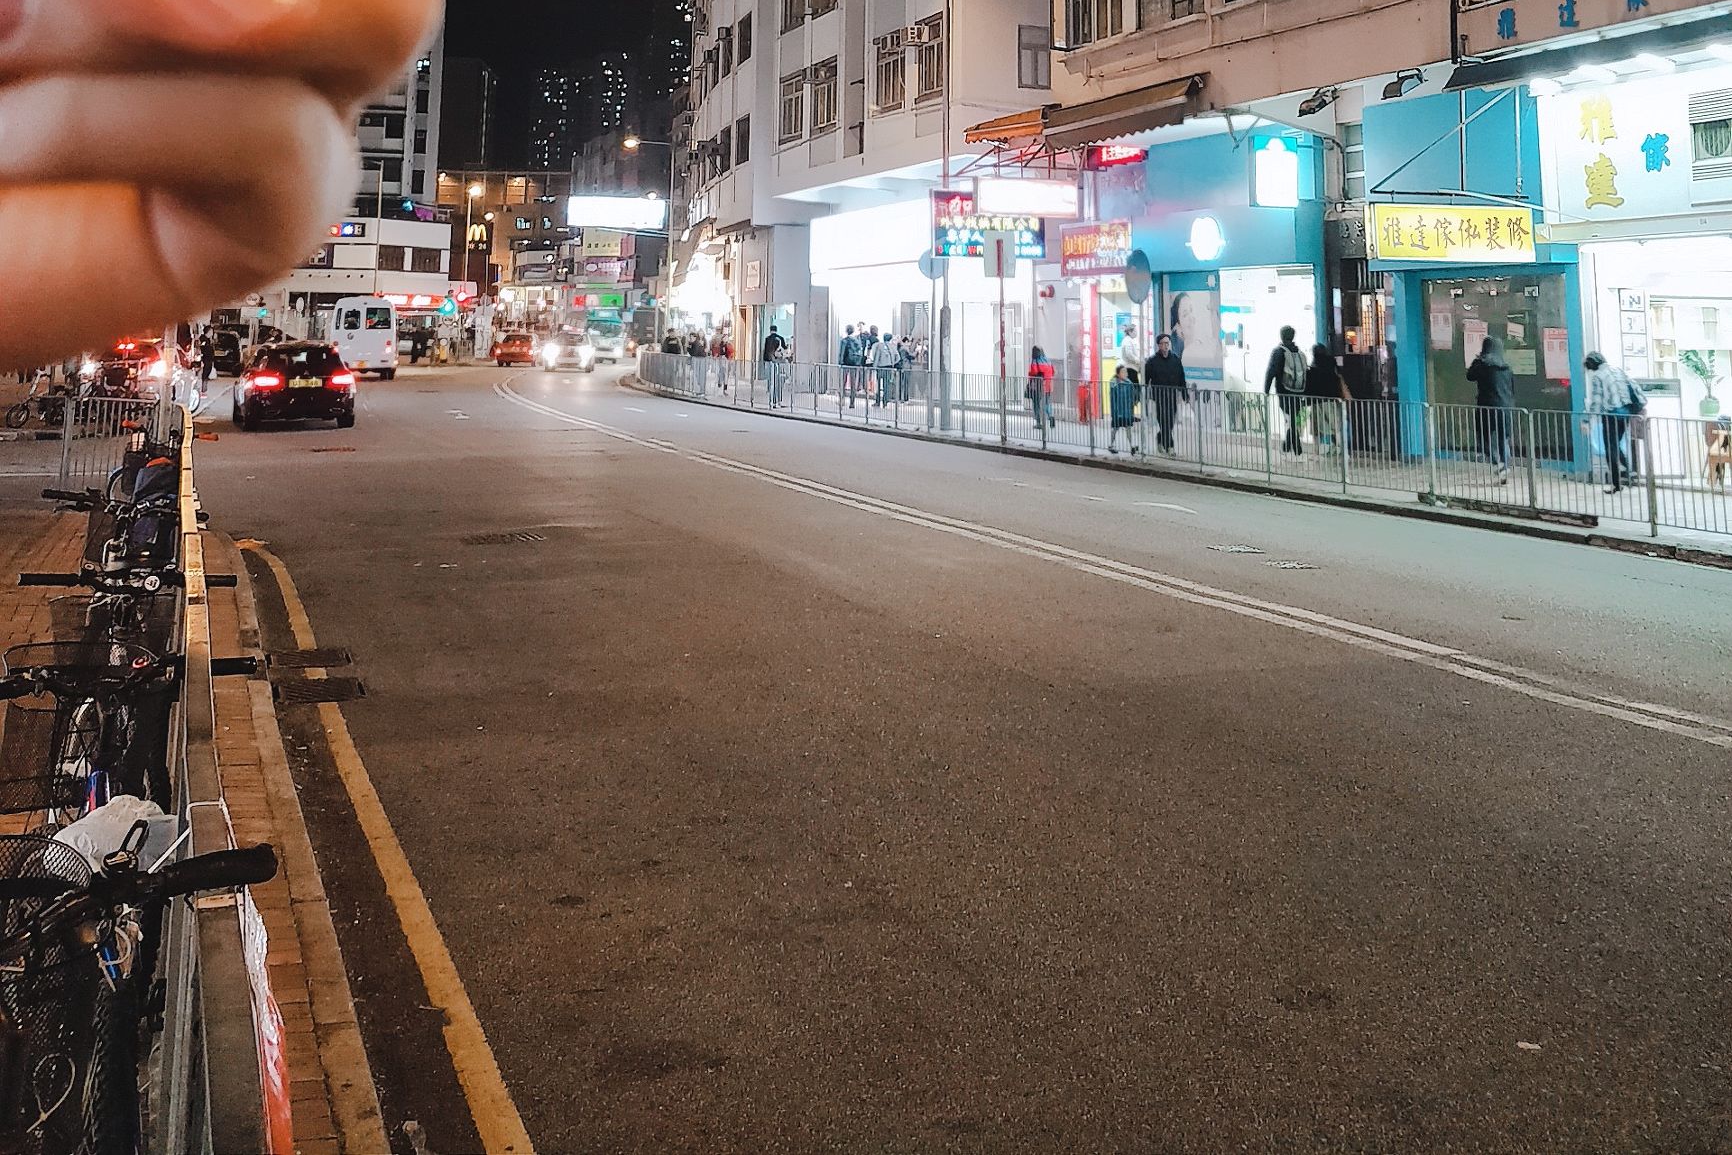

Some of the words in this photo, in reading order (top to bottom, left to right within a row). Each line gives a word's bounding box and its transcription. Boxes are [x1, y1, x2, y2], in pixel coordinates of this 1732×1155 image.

[1383, 214, 1530, 251] 雅達傢俬裝修
